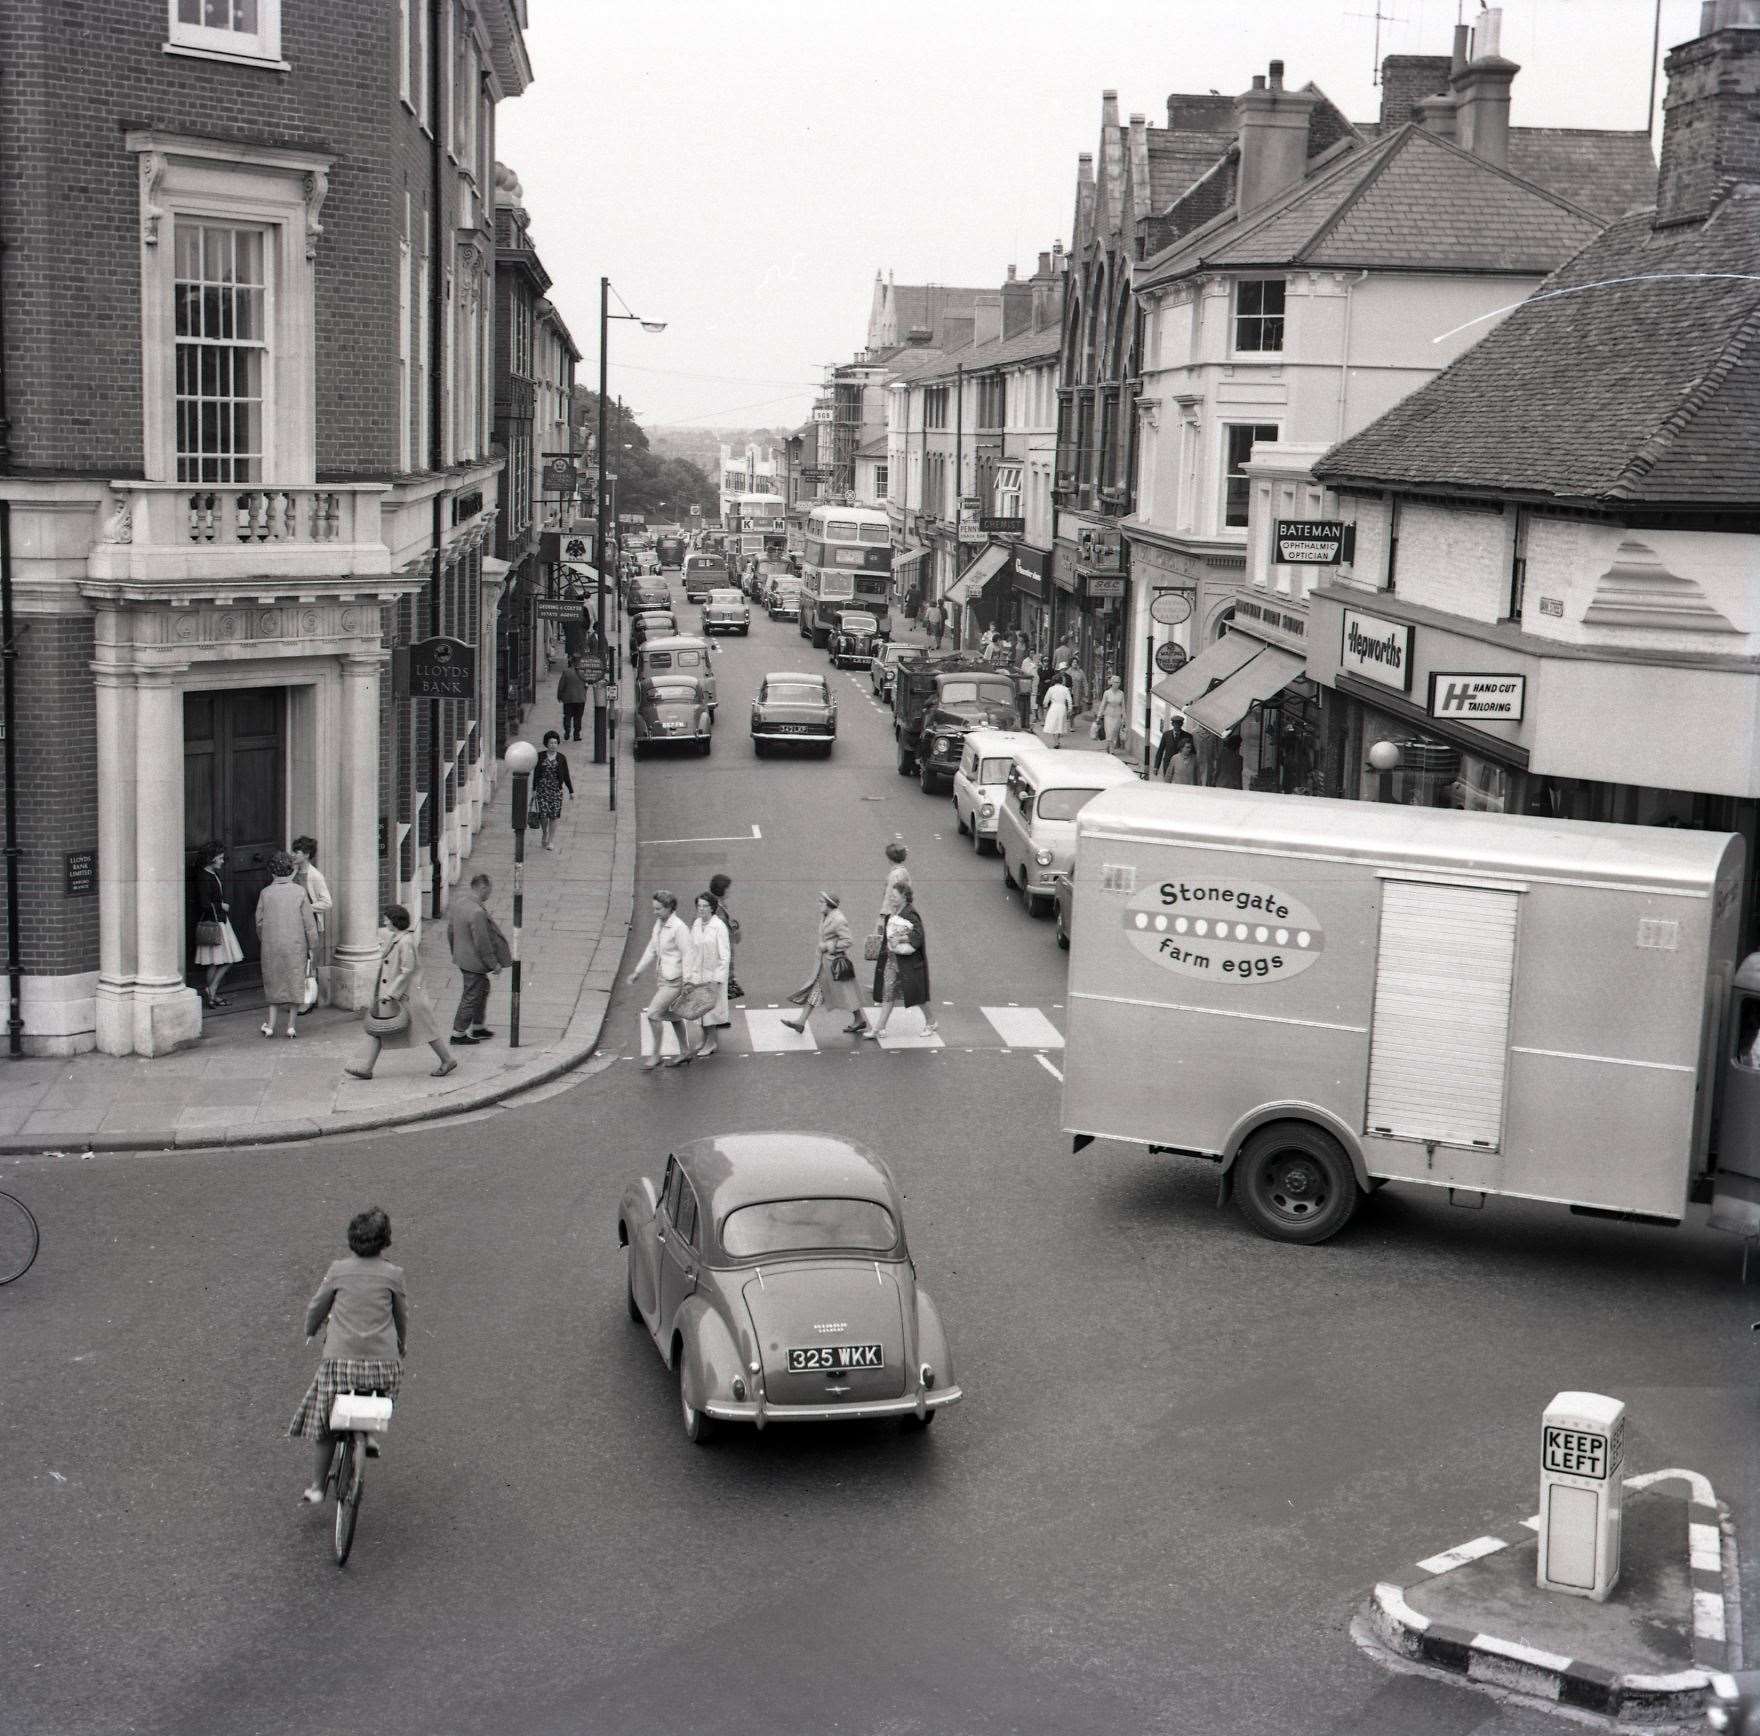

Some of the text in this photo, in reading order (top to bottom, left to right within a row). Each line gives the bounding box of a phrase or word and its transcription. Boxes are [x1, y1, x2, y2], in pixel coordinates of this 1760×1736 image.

[743, 520, 751, 529] K
[775, 520, 784, 529] M
[984, 520, 1022, 530] CHEMIST
[1280, 524, 1340, 537] BATEMAN
[1283, 541, 1336, 551] OPHTHALMIC
[1289, 551, 1329, 560] OPTICIAN
[1348, 621, 1402, 669] Hepworths
[416, 665, 471, 678] LLOYDS
[423, 681, 462, 693] BANK
[1473, 683, 1516, 693] HAND CUT
[1442, 683, 1477, 710] H
[1468, 702, 1511, 712] TAILORING
[70, 856, 92, 864] LLOYDS
[70, 869, 92, 877] LIMITED
[1160, 883, 1289, 918] Stonegate
[1159, 938, 1284, 978] farm eggs
[793, 1346, 878, 1368] 325 WKK
[1549, 1431, 1603, 1454] KEEP
[1551, 1450, 1600, 1473] LEFT
